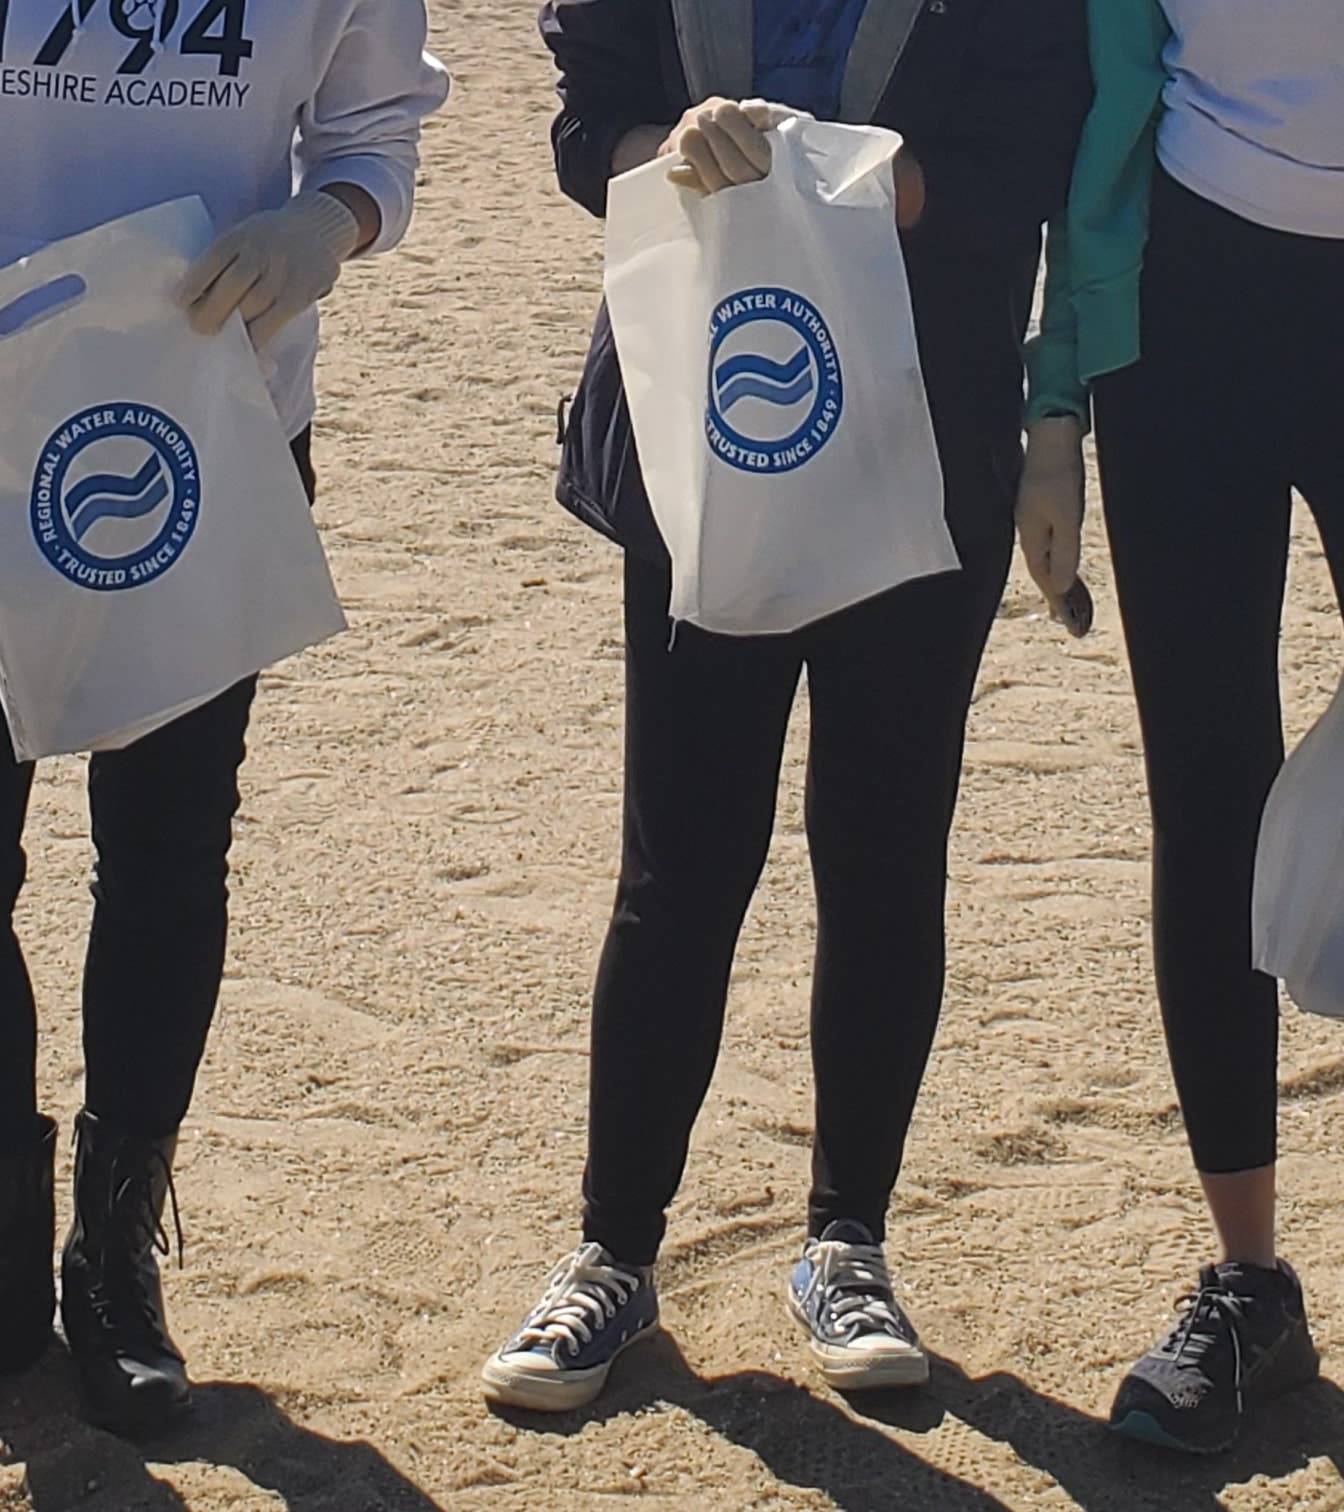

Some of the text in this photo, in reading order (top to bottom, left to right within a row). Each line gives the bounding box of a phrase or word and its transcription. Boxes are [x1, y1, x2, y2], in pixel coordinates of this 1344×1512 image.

[104, 80, 251, 108] ACADEMY
[717, 293, 839, 383] WATER AUTHORITY
[37, 410, 196, 543] REGIONAL WATER AUTHORITY
[705, 401, 838, 467] TRUSTED SINCE 1849
[57, 500, 195, 585] TRUSTED SINCE 1849
